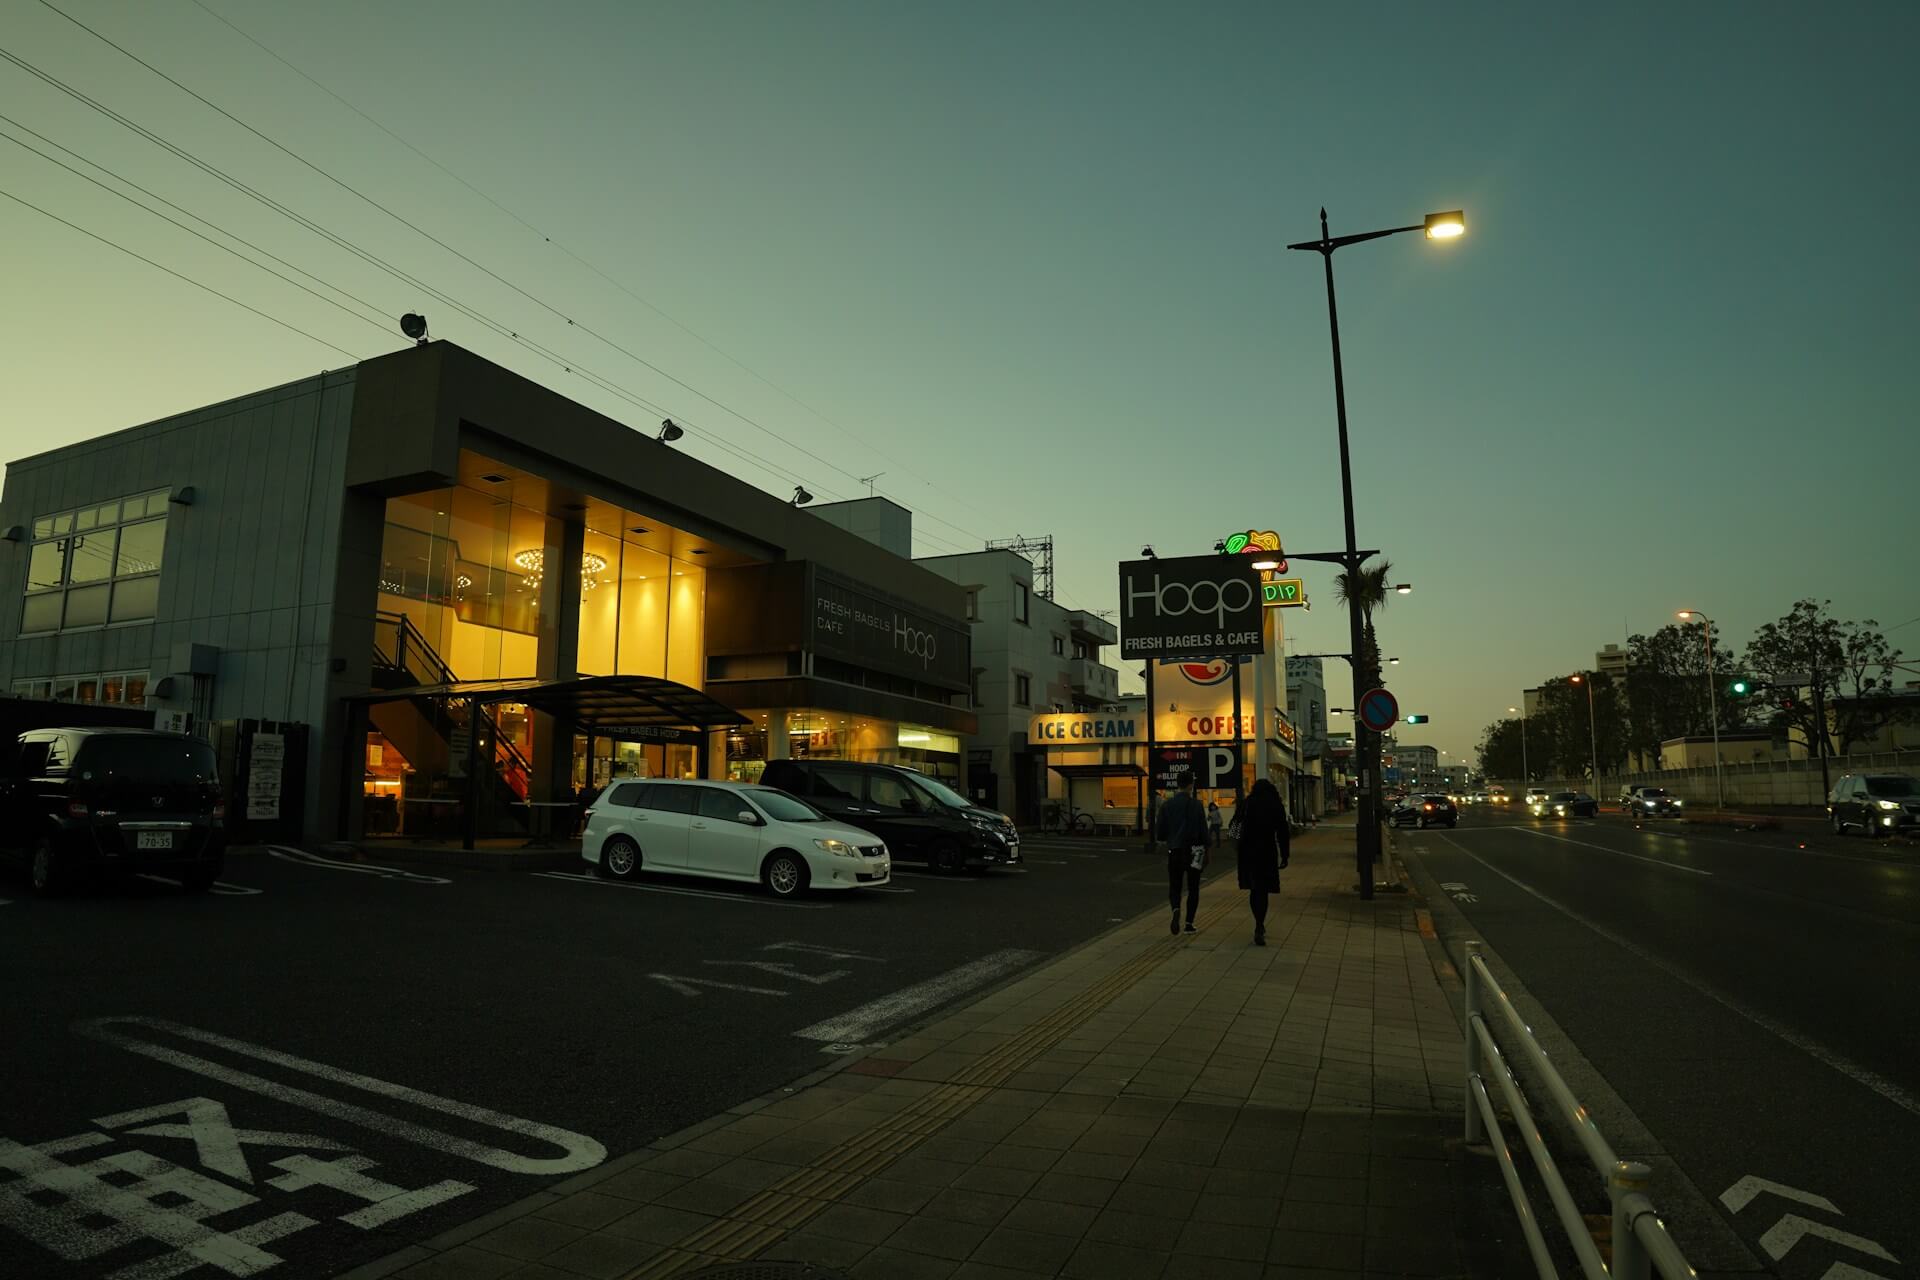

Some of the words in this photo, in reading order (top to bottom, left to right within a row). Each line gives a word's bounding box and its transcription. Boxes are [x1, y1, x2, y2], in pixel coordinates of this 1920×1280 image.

[1128, 574, 1252, 629] Hoop
[1264, 585, 1295, 600] DIP
[817, 598, 851, 619] FRESH
[855, 611, 890, 632] BAGELS
[817, 617, 843, 635] CAFE
[894, 614, 936, 671] Hoop
[1125, 637, 1162, 650] FRESH
[1166, 634, 1212, 648] BAGELS
[1215, 633, 1224, 646] &
[1227, 632, 1259, 644] CAFE
[1038, 722, 1065, 739] ICE
[1070, 720, 1135, 738] CREAM
[1169, 764, 1190, 772] HOOP
[1208, 748, 1234, 787] P
